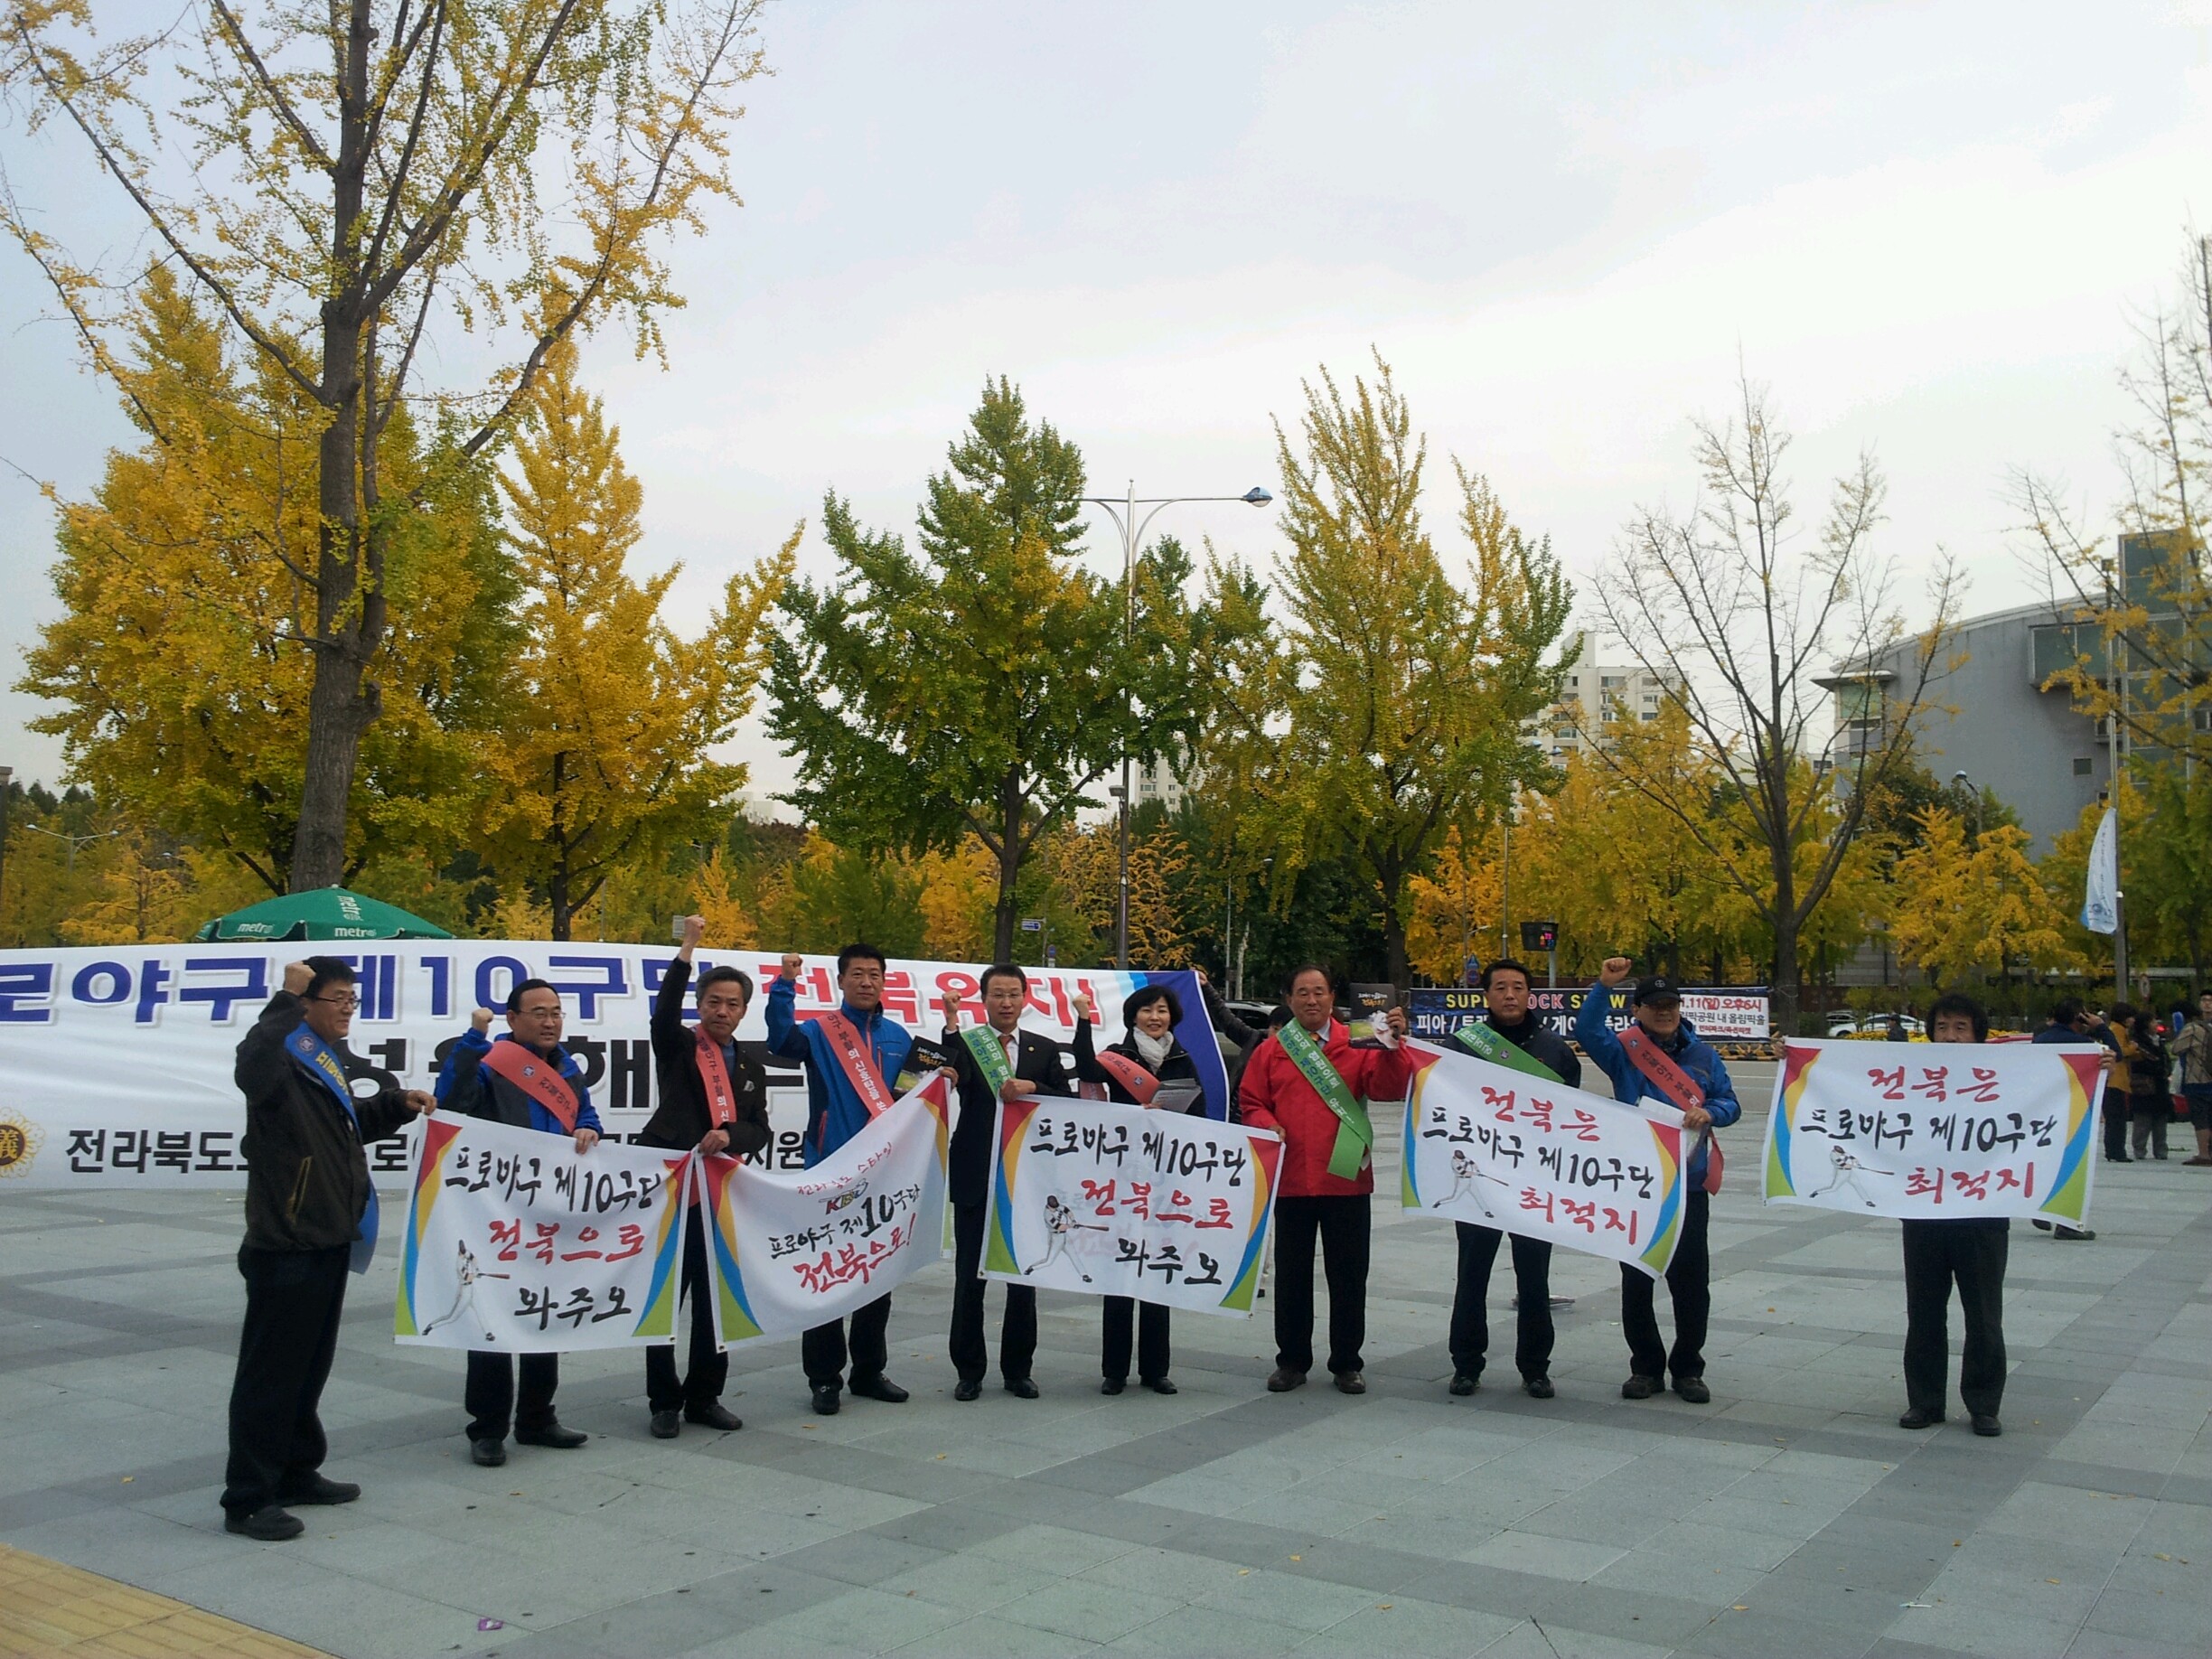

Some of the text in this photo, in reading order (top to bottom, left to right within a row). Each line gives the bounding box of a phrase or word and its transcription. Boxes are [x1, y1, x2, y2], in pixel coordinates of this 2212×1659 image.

[1446, 993, 1489, 1008] SUPE
[1526, 993, 1564, 1009] OCK
[1928, 1111, 2058, 1153] 제10구단
[1141, 1130, 1247, 1187] 제10구단
[1537, 1146, 1655, 1200] 제10구단
[1905, 1161, 2036, 1204] 최적지
[767, 1183, 921, 1260] 프로야구 제10구단
[1080, 1178, 1233, 1230] 전북으로
[1518, 1186, 1638, 1246] 최적지
[489, 1218, 646, 1265] 전북으로
